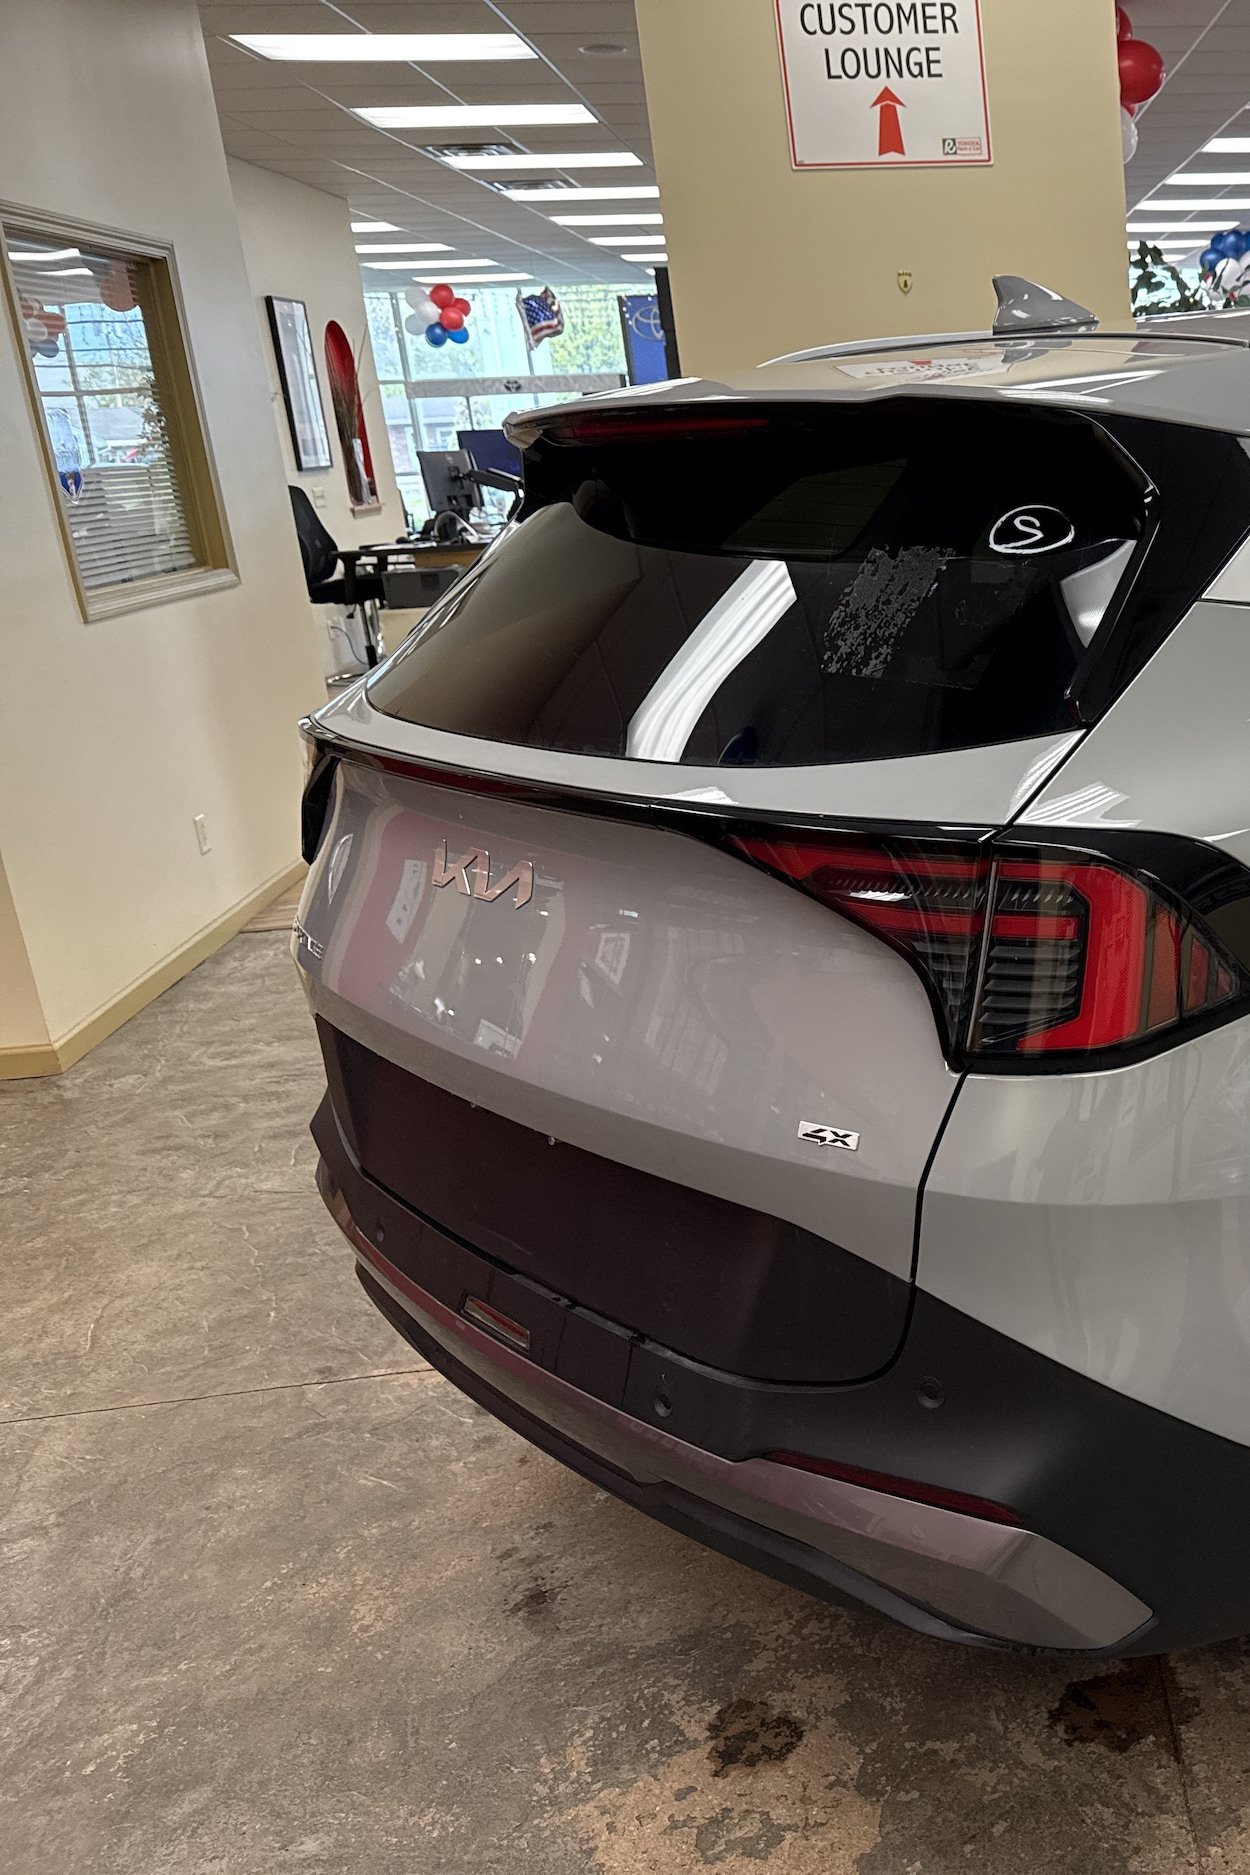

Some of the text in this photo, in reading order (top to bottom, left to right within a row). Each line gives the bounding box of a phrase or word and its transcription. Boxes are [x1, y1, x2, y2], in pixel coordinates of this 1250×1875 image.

[800, 2, 959, 36] CUSTOMER
[824, 46, 943, 79] LOUNGE
[431, 838, 534, 909] KIA
